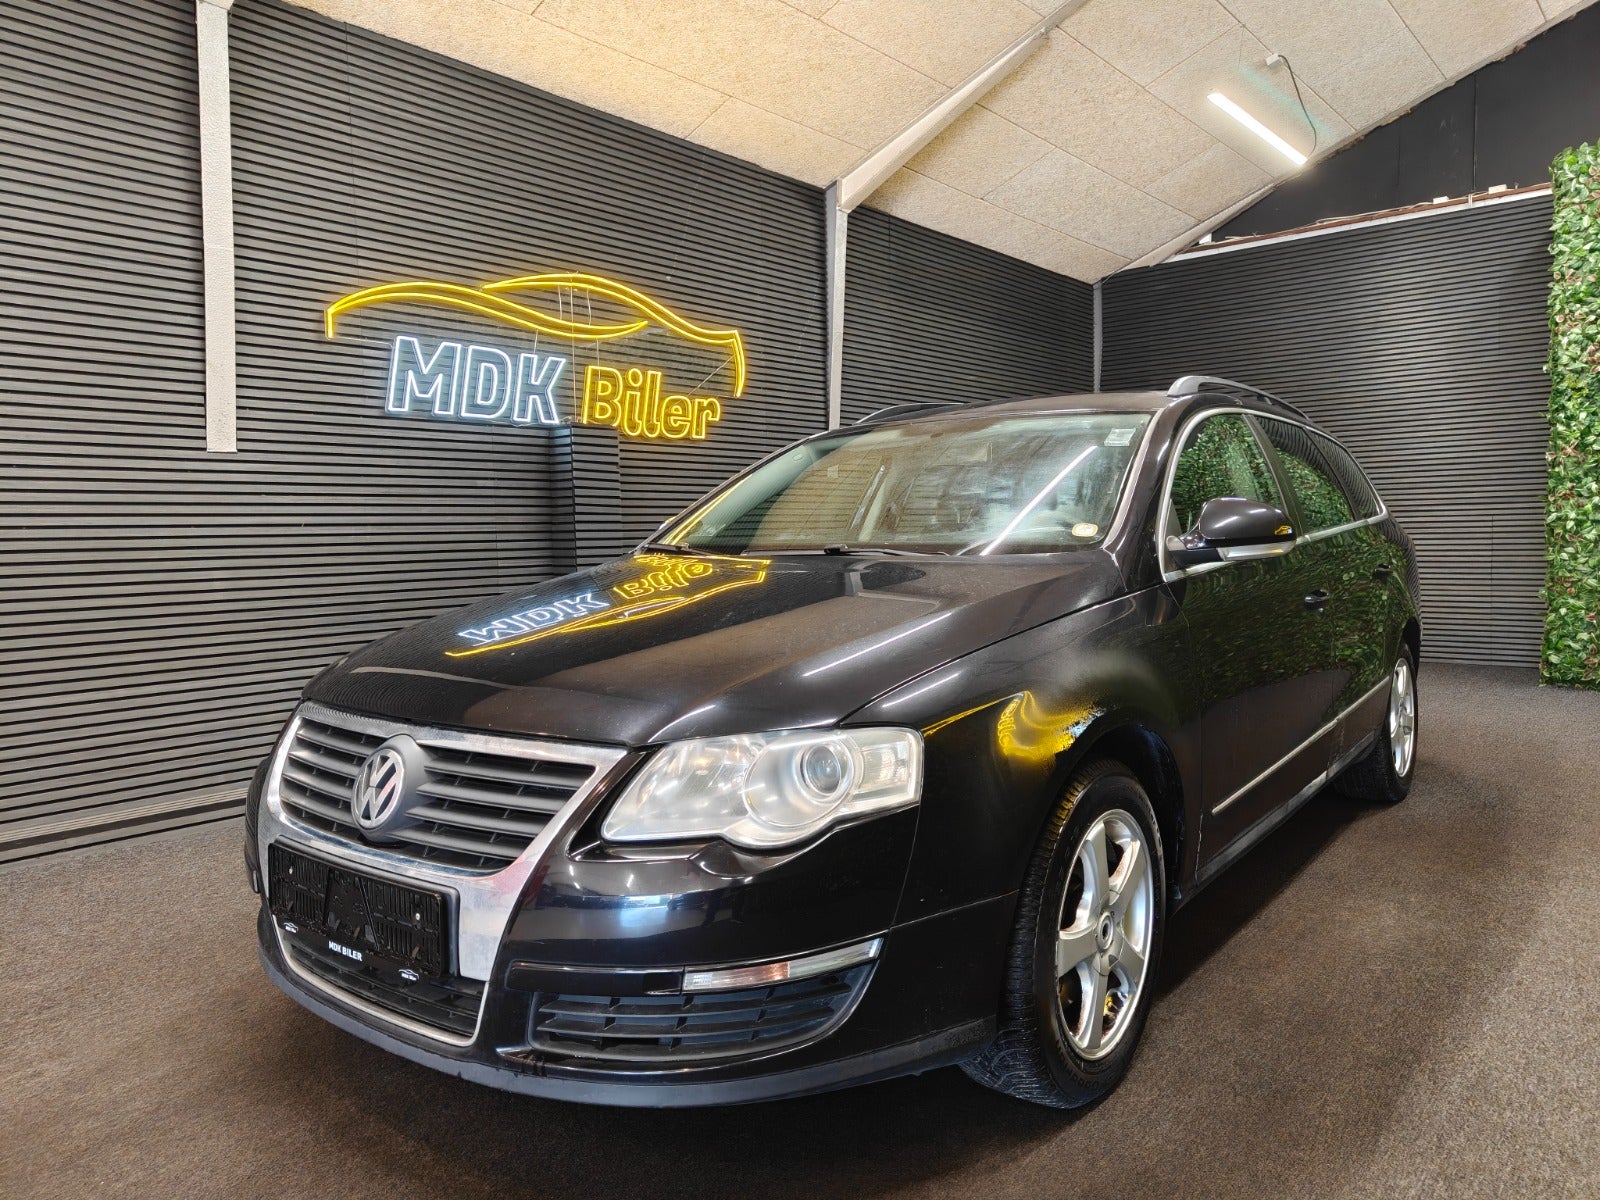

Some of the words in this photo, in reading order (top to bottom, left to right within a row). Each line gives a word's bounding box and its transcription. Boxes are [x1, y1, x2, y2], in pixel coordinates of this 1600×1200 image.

[386, 335, 567, 424] MDK
[581, 364, 721, 440] Biler
[328, 940, 341, 953] MDK
[342, 946, 363, 962] BILER
